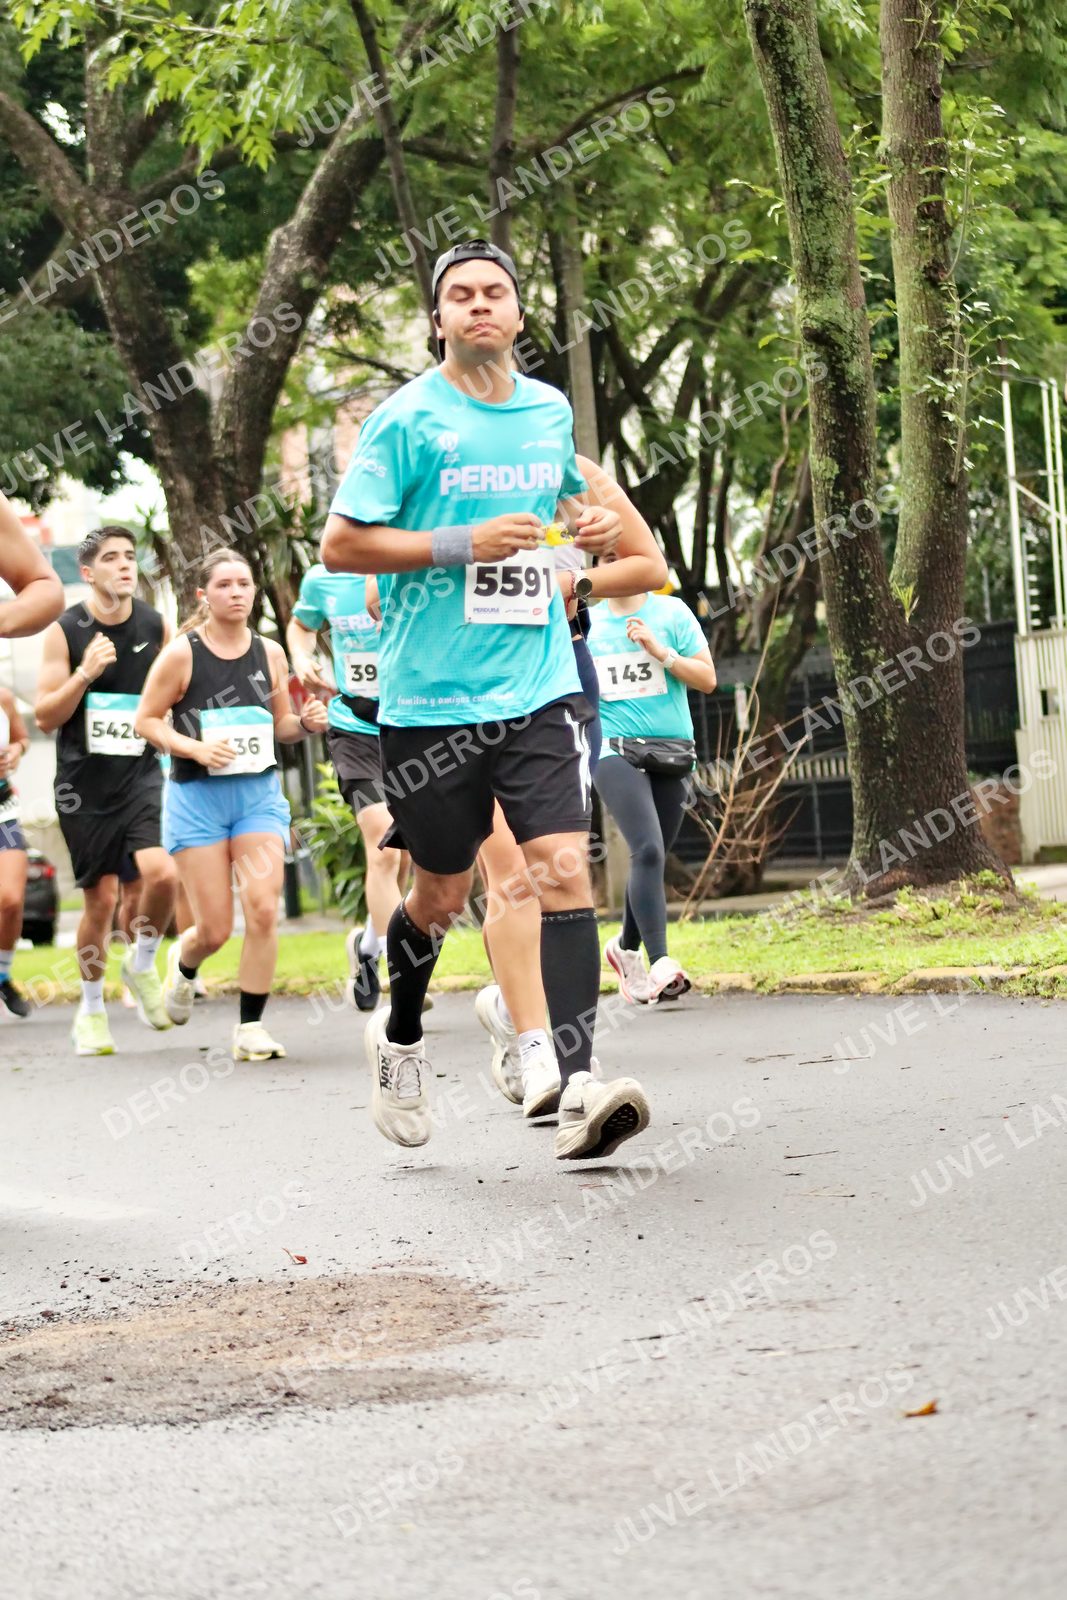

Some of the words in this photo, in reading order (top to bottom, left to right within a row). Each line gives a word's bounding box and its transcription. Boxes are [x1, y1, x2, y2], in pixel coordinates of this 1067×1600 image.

[474, 566, 551, 598] 5591
[608, 663, 652, 685] 143
[397, 695, 427, 705] familia
[430, 698, 436, 707] y
[438, 696, 469, 706] amigos
